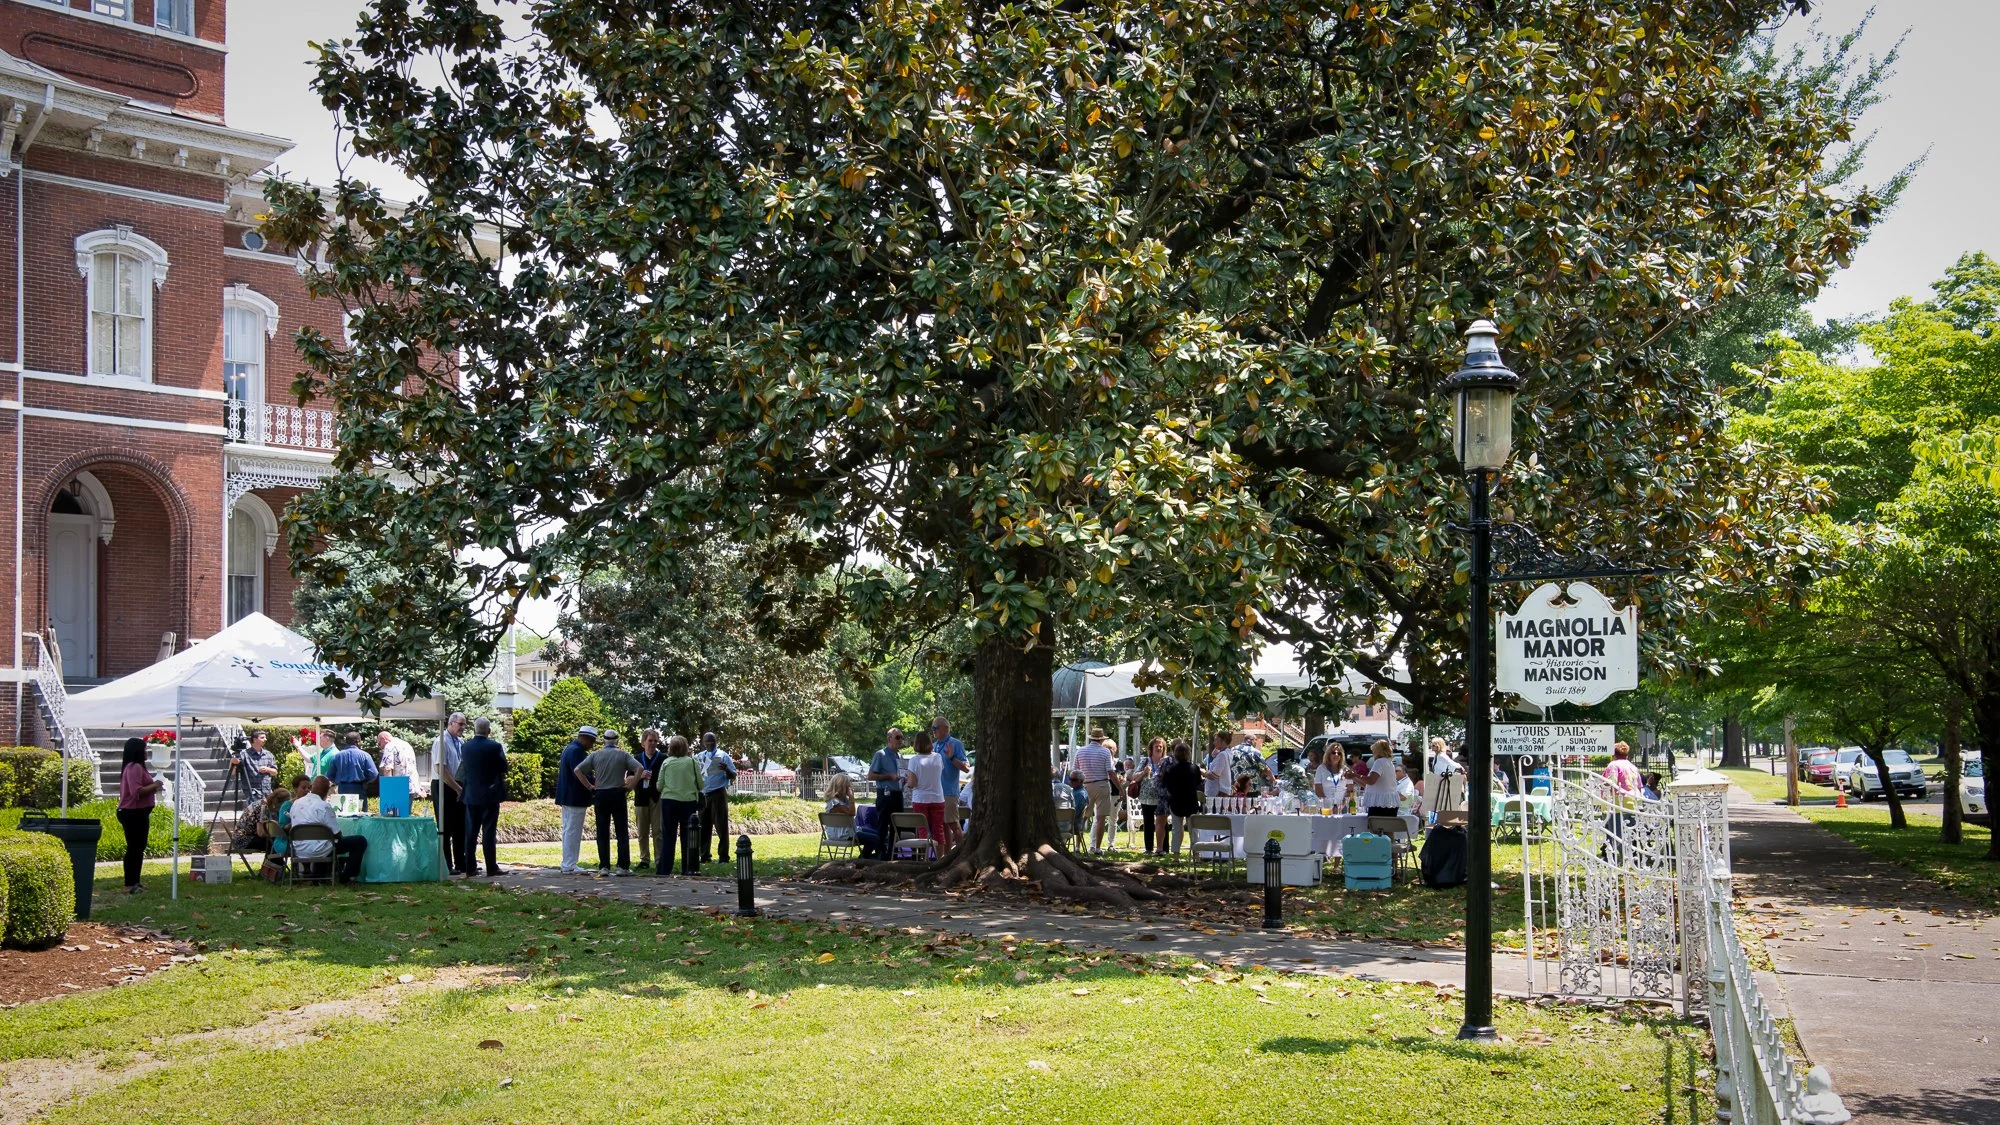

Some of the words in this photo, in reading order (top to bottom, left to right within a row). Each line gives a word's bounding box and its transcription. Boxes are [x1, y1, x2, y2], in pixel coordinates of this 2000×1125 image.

[1505, 616, 1627, 639] MAGNOLIA
[1524, 638, 1606, 659] MANOR
[1546, 658, 1584, 668] Historic
[1524, 666, 1607, 682] MANSION
[1545, 686, 1567, 695] Built
[1568, 685, 1587, 695] 1869
[1514, 726, 1550, 737] TOURS
[1554, 726, 1591, 737] DAILY
[1569, 737, 1598, 745] SUNDAY
[1597, 745, 1608, 753] PM
